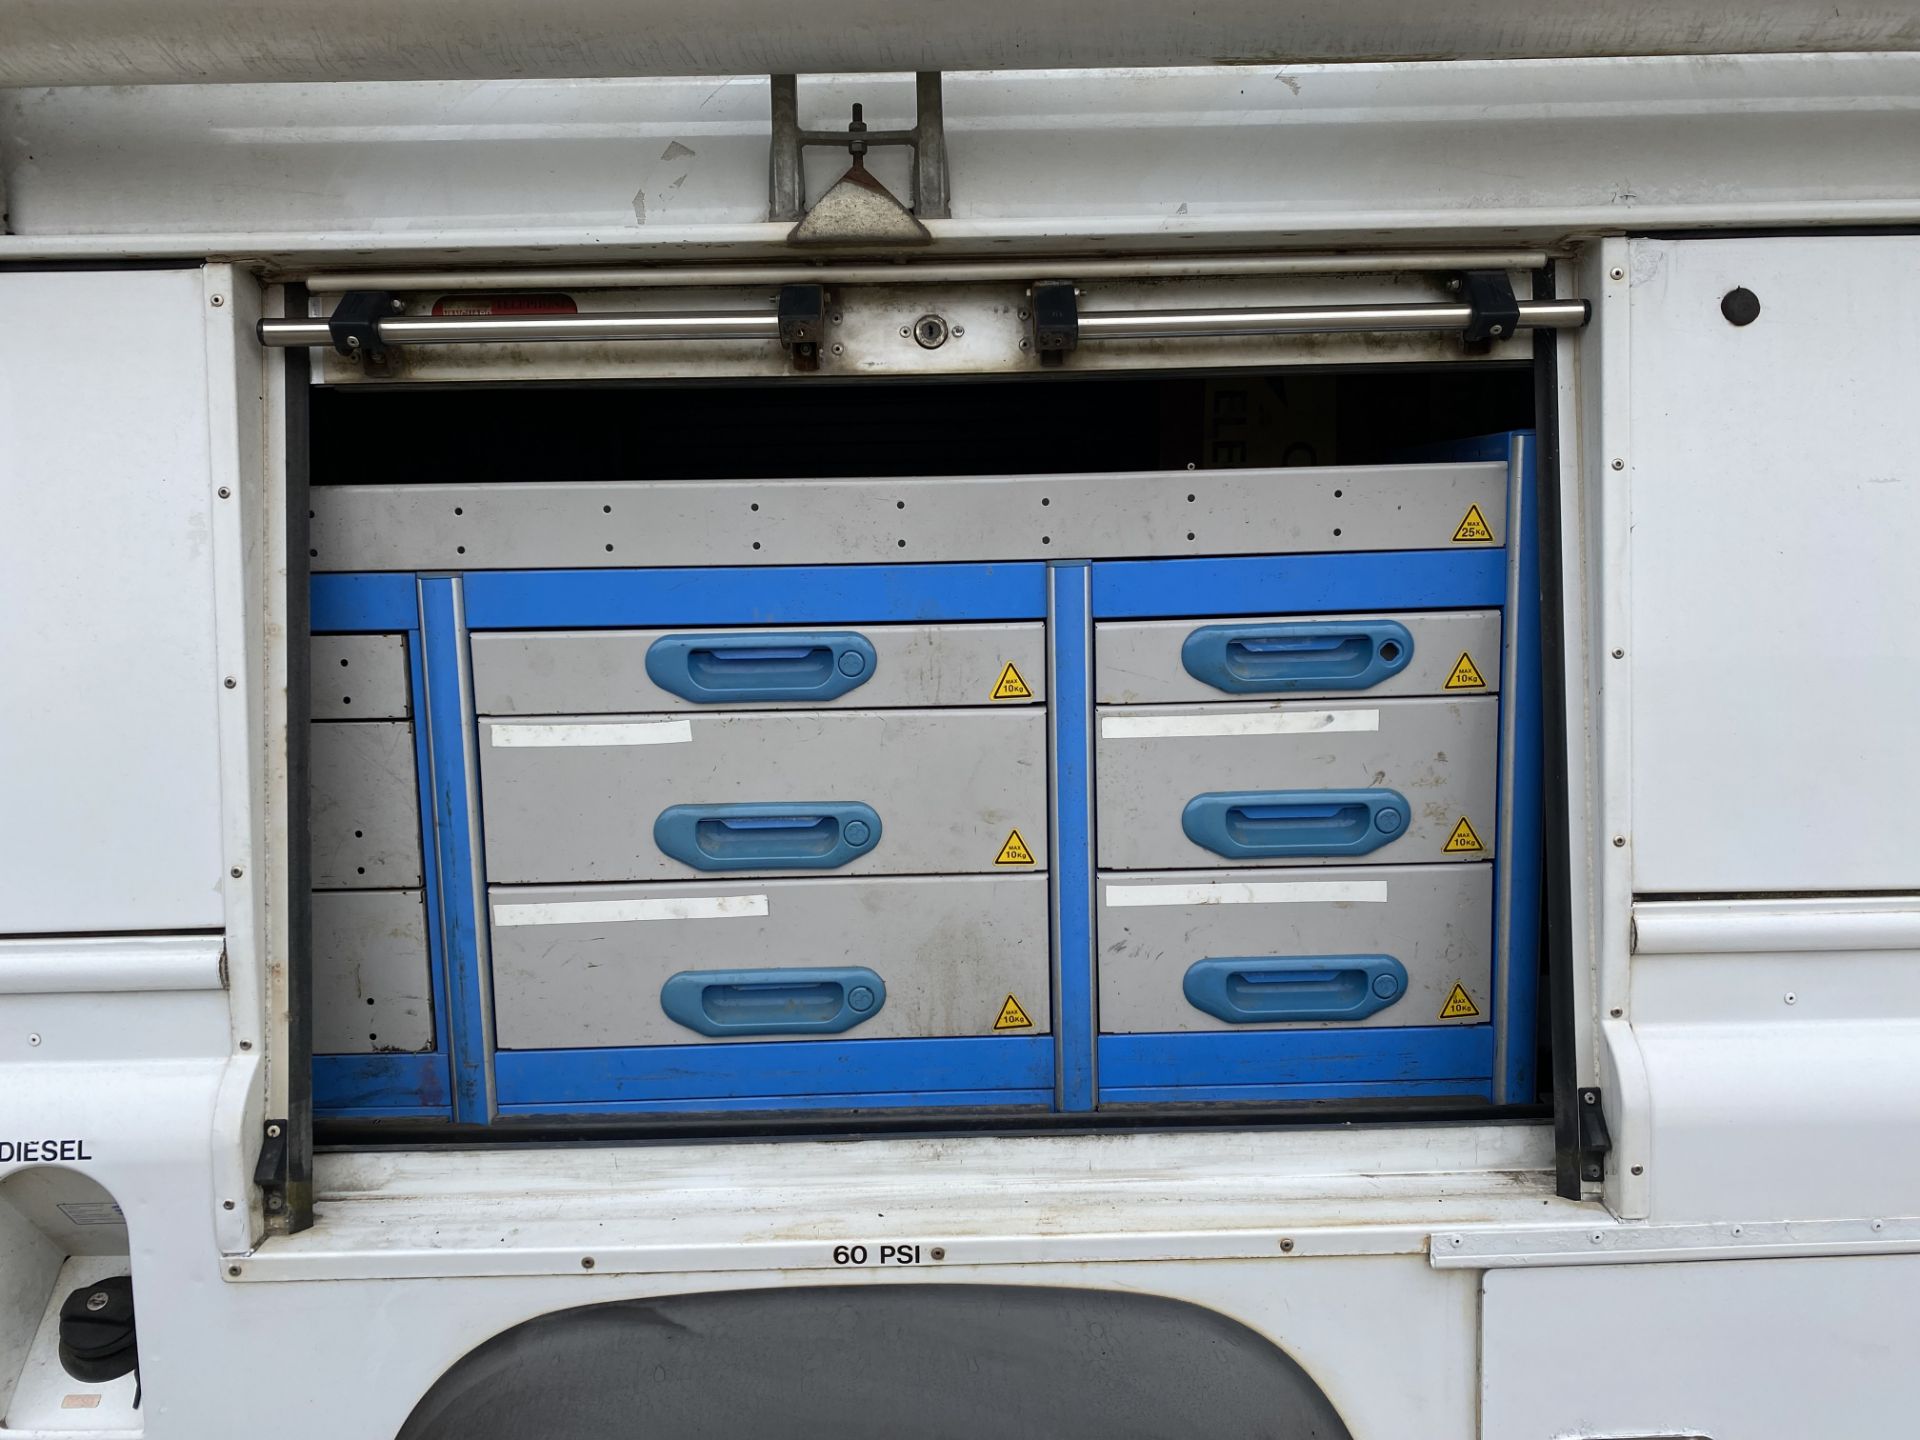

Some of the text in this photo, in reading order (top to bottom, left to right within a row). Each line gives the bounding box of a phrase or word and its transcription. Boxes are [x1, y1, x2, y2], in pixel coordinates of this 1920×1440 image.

[0, 1139, 92, 1162] DIESEL
[833, 1244, 920, 1265] 60 PSI
